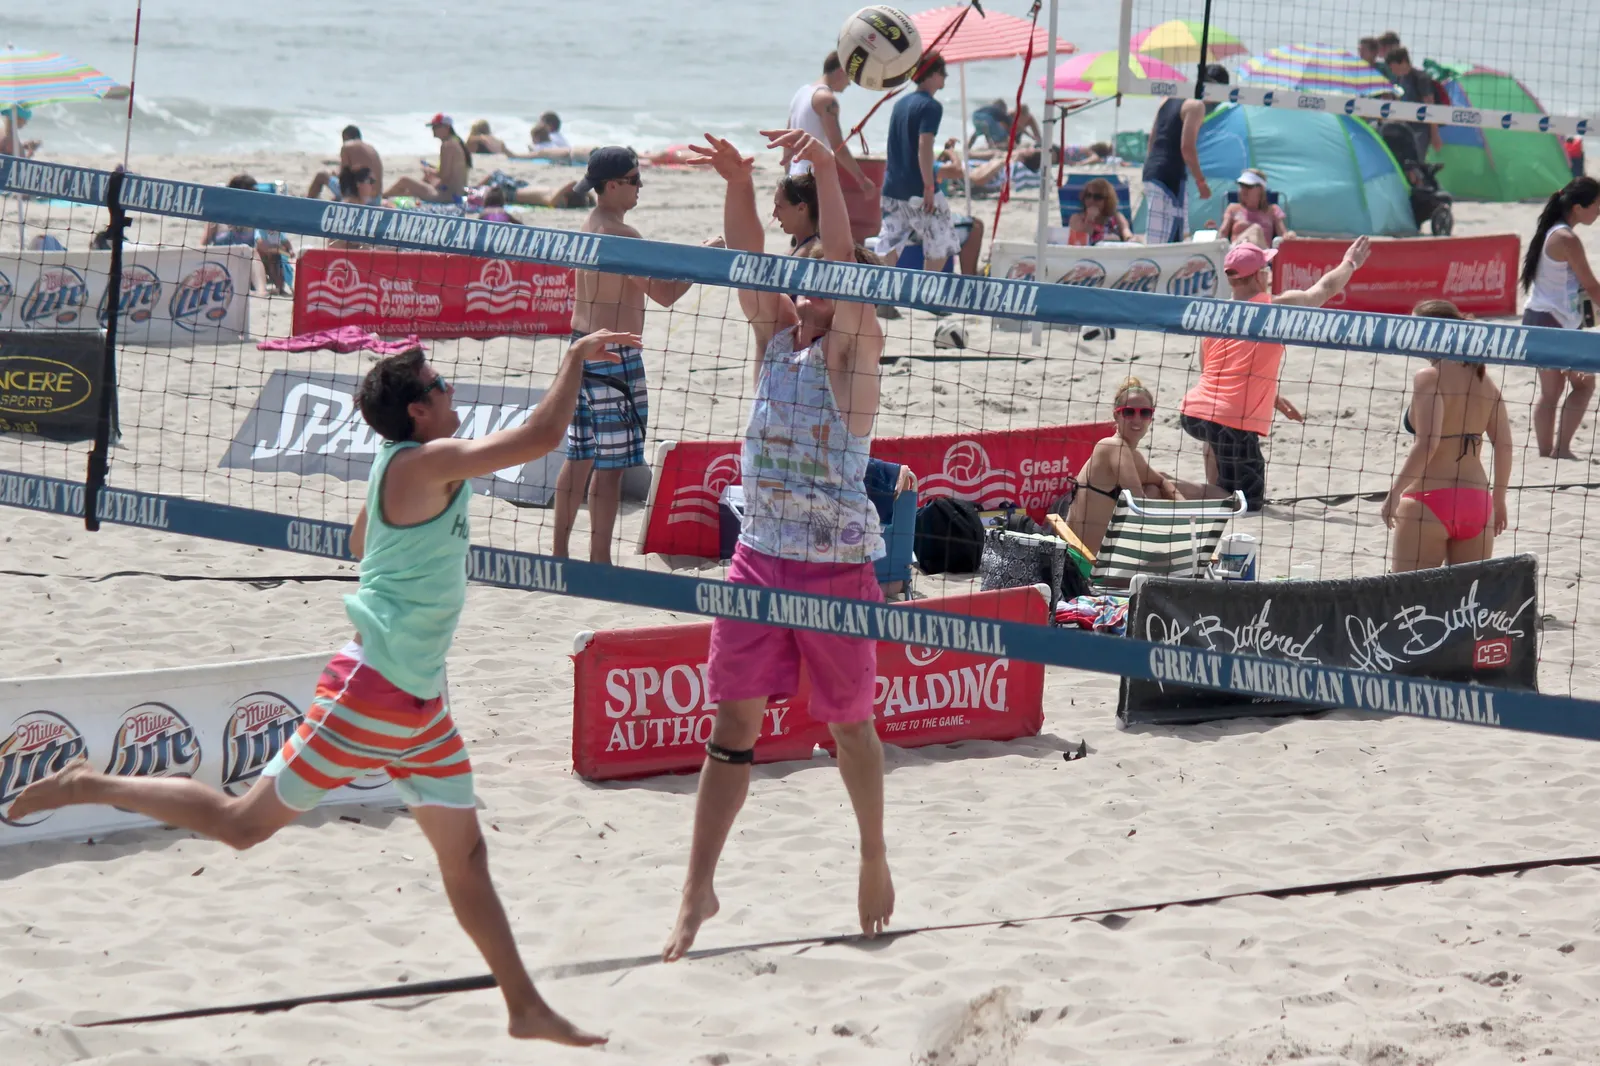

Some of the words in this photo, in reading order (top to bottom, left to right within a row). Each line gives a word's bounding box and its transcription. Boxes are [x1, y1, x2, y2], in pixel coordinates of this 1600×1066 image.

[5, 160, 95, 200] AMERICAN
[99, 174, 204, 216] VLLEYBALL
[321, 204, 383, 239] GREAT
[382, 210, 479, 251] AMERICAN
[484, 222, 602, 266] VOLLEYBALL
[379, 277, 414, 293] Great
[532, 274, 567, 287] Great
[729, 253, 800, 289] GREAT
[800, 262, 908, 302] AMERICAN
[911, 273, 1041, 316] VOLLEYBALL
[379, 292, 441, 306] American
[379, 304, 443, 319] Volleyball
[1181, 300, 1259, 335] GREAT
[1258, 308, 1382, 347] AMERICAN
[1383, 319, 1530, 361] VOLLEYBALL
[1, 394, 53, 408] SPORTS
[1020, 456, 1069, 476] Great
[1020, 472, 1076, 494] Ameri
[0, 473, 58, 511] ERICAN
[63, 483, 169, 528] VOLEYBALL
[286, 520, 347, 557] GREAT
[465, 549, 567, 592] OLLEYBALL
[696, 586, 761, 620] GREAT
[766, 594, 870, 636] AMERICAN
[874, 605, 1006, 655] VOLLEYBALL
[1393, 579, 1535, 656] Buttered
[873, 658, 1010, 720] PALDING
[1149, 647, 1223, 687] GREAT
[1229, 656, 1345, 706] AMERICAN
[1352, 673, 1500, 725] VOLLEYBALL
[125, 712, 176, 742] Miller
[235, 700, 287, 731] Miller
[885, 721, 907, 733] TRUE
[909, 719, 920, 730] TO
[921, 717, 937, 729] THE
[938, 714, 965, 727] GAME
[17, 720, 67, 750] Miller
